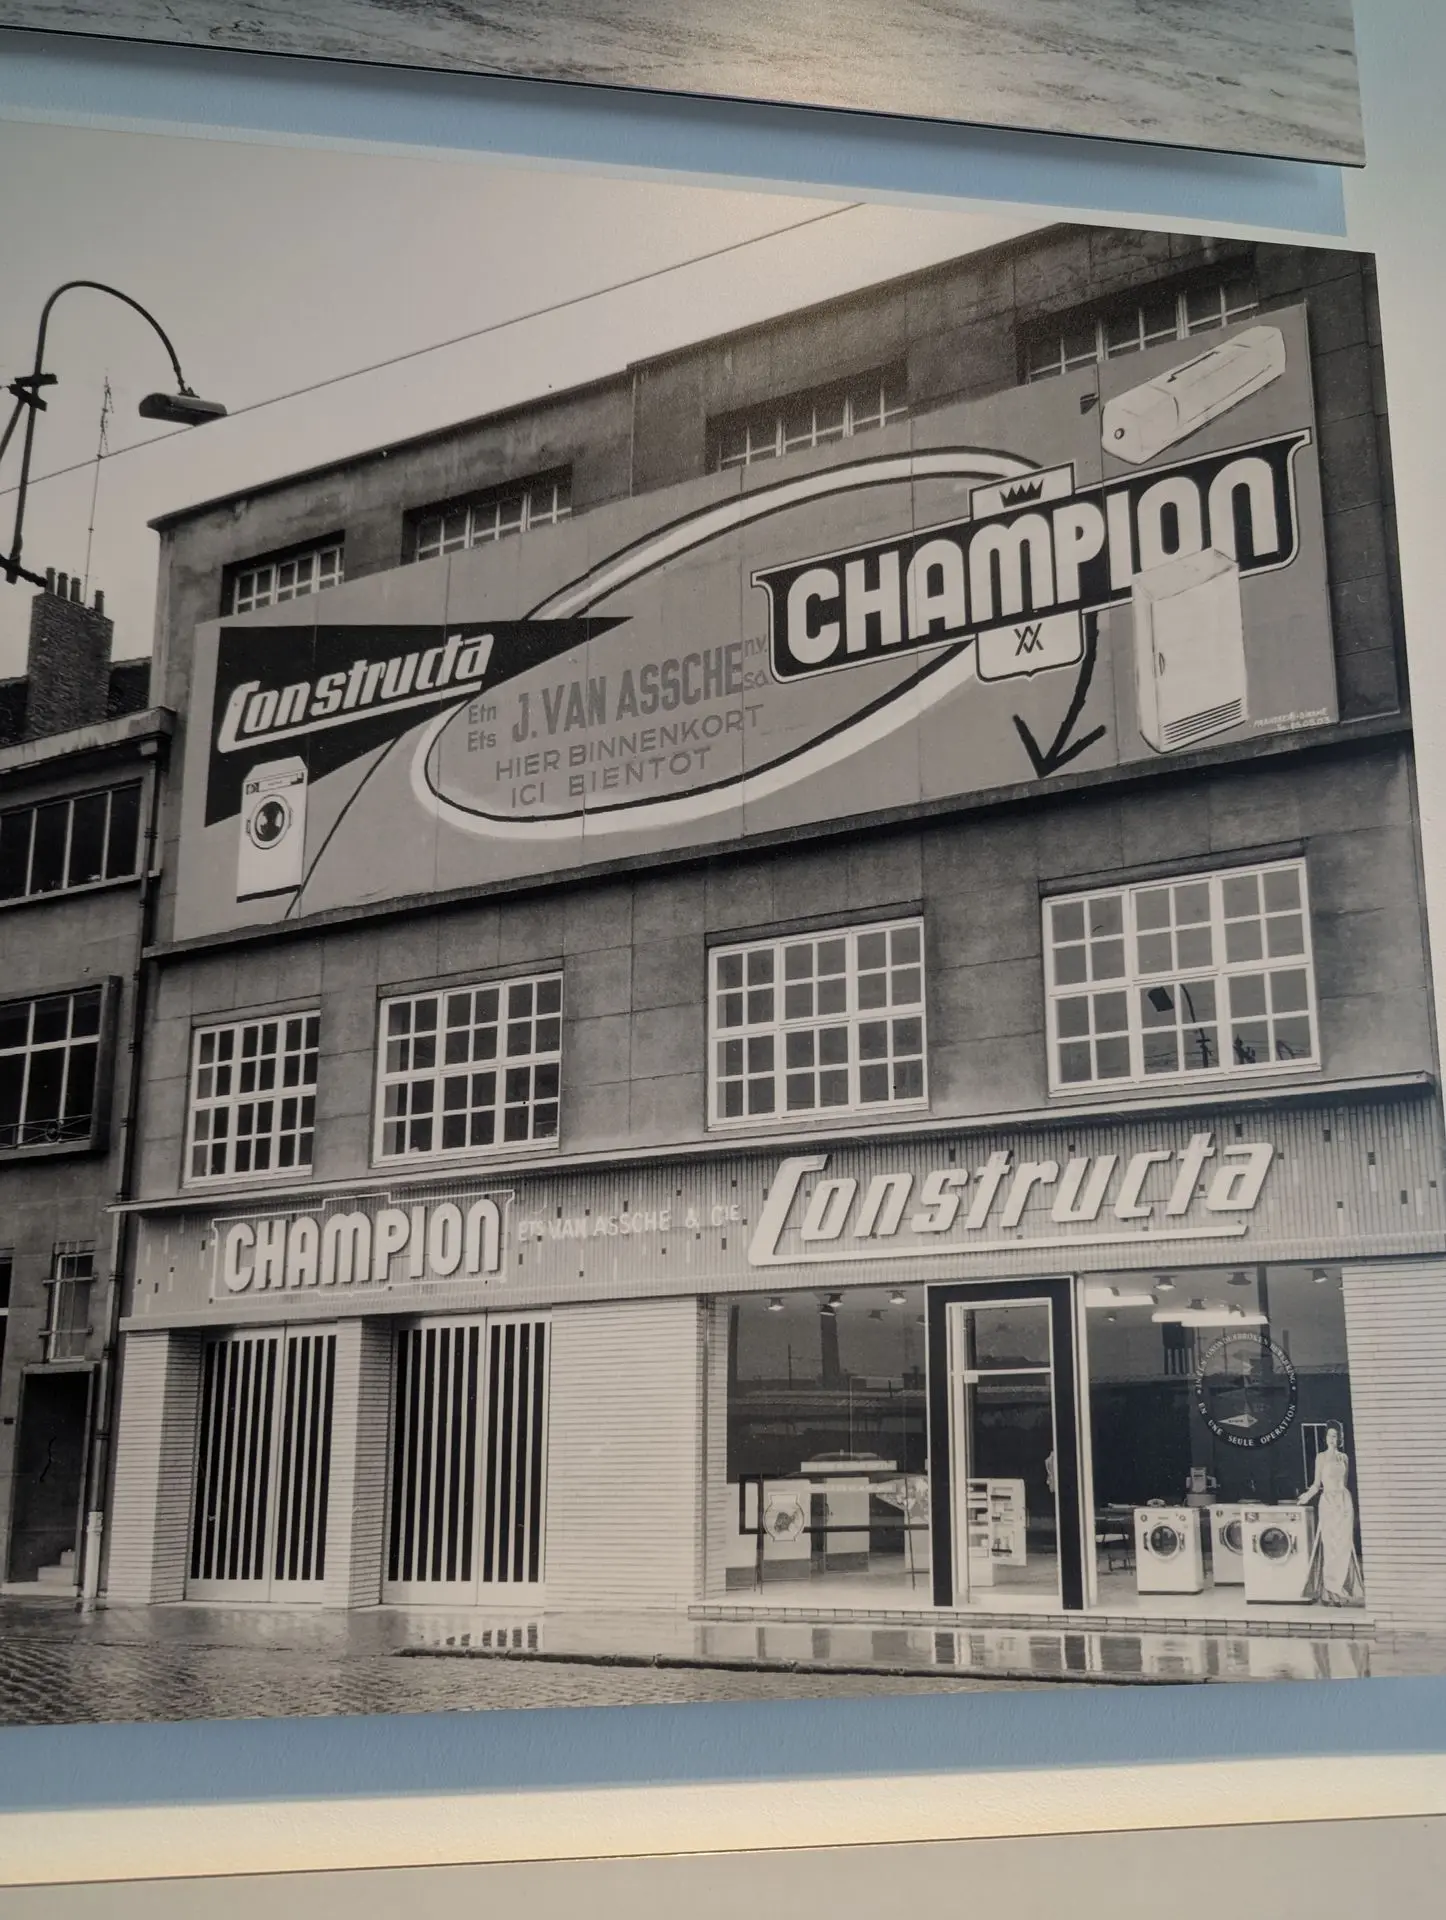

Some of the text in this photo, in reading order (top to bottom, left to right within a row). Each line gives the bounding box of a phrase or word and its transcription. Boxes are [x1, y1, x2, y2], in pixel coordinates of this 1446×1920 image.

[786, 457, 1280, 664] CHAMPION
[216, 632, 495, 753] Constructa
[467, 704, 497, 725] Etn
[616, 642, 742, 722] ASSCHE
[467, 731, 497, 752] Ets
[496, 703, 765, 781] HIER BINNENKORT
[511, 782, 546, 808] ICI
[550, 1217, 588, 1240] VAN
[593, 1210, 672, 1237] ASSCHE
[684, 1207, 699, 1229] &
[747, 1132, 1274, 1266] Constructa
[223, 1197, 499, 1293] CHAMPION
[1207, 1419, 1223, 1435] UNE
[1228, 1435, 1254, 1447] SEULE
[1260, 1404, 1296, 1444] OPERATION
